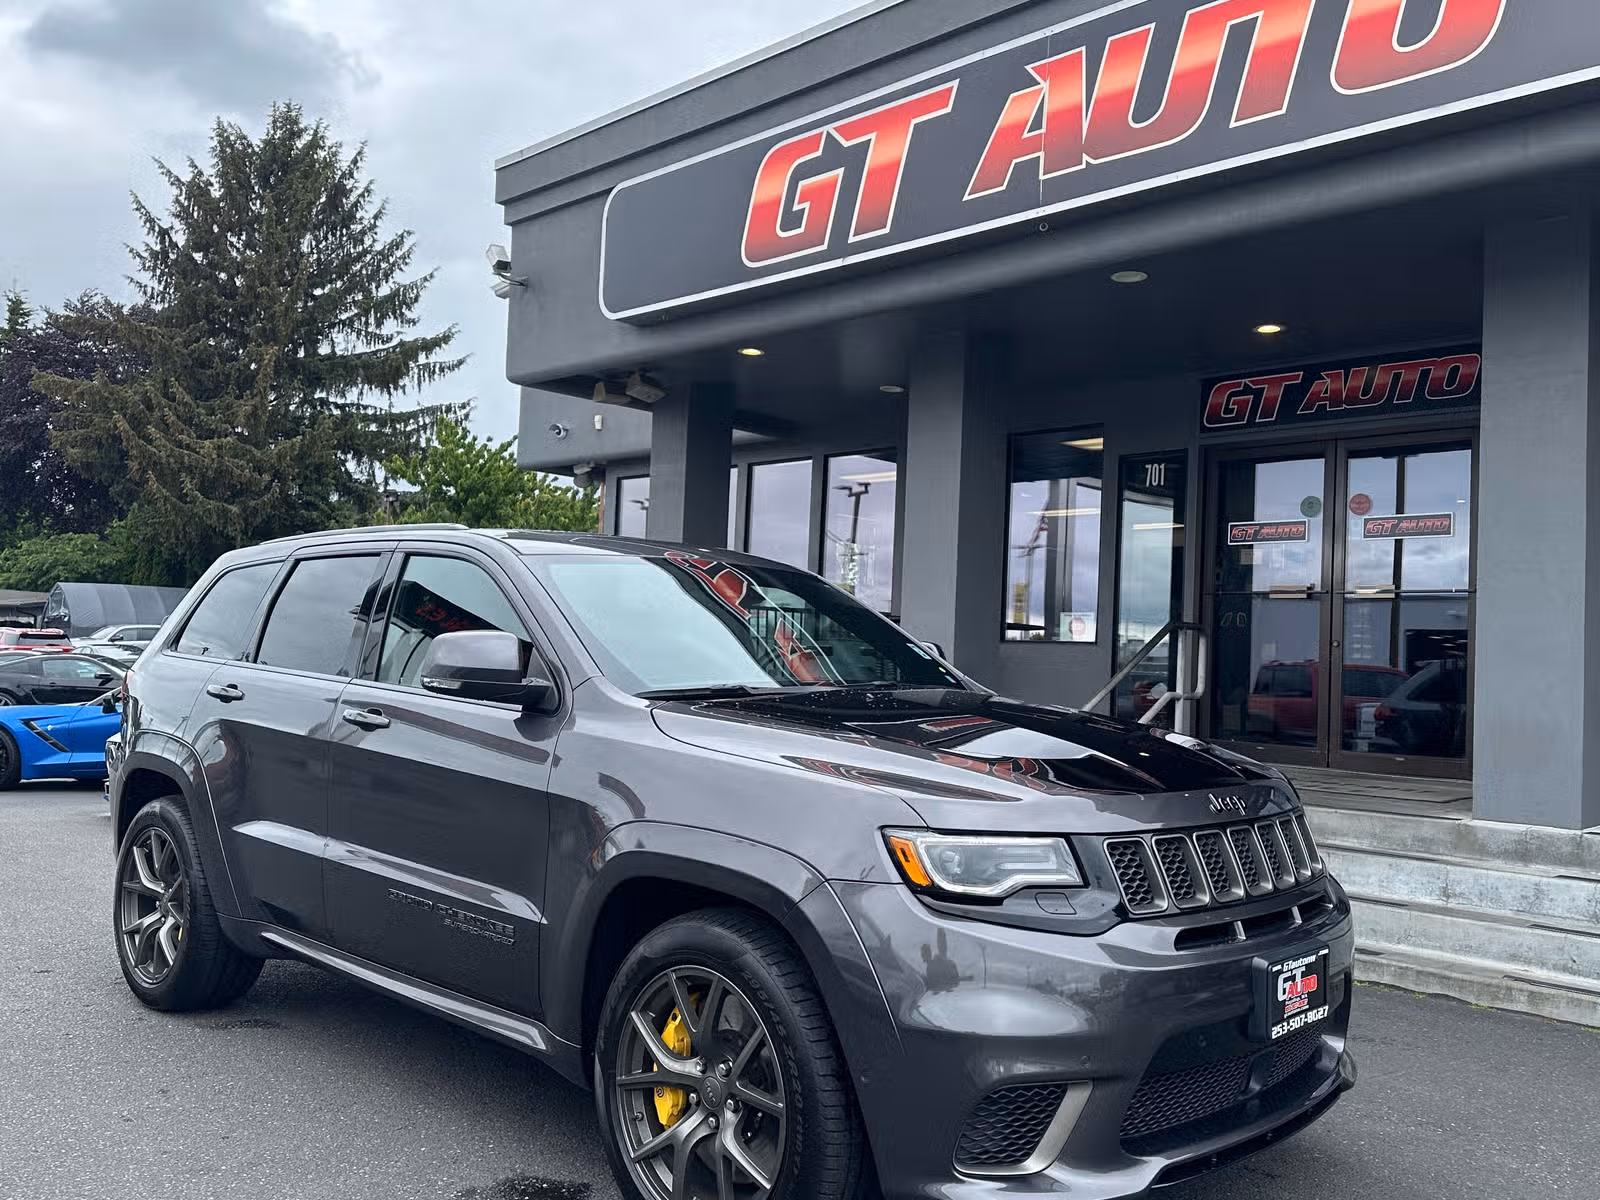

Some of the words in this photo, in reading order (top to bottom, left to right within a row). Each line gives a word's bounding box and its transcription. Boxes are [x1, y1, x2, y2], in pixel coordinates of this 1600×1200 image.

[741, 78, 959, 268] GT
[1203, 371, 1303, 428] GT
[1297, 353, 1481, 415] AUTO
[1144, 462, 1166, 488] 701
[1231, 525, 1260, 541] GT
[1257, 524, 1305, 539] AUTO
[1365, 519, 1398, 536] GT
[1396, 517, 1450, 534] AUTO
[1208, 793, 1246, 816] Jeep
[436, 903, 515, 936] CHEROKEE
[443, 918, 515, 946] SUPERCHARGED
[1286, 974, 1318, 1000] AUTO
[1271, 1004, 1329, 1040] 253-507-8027
